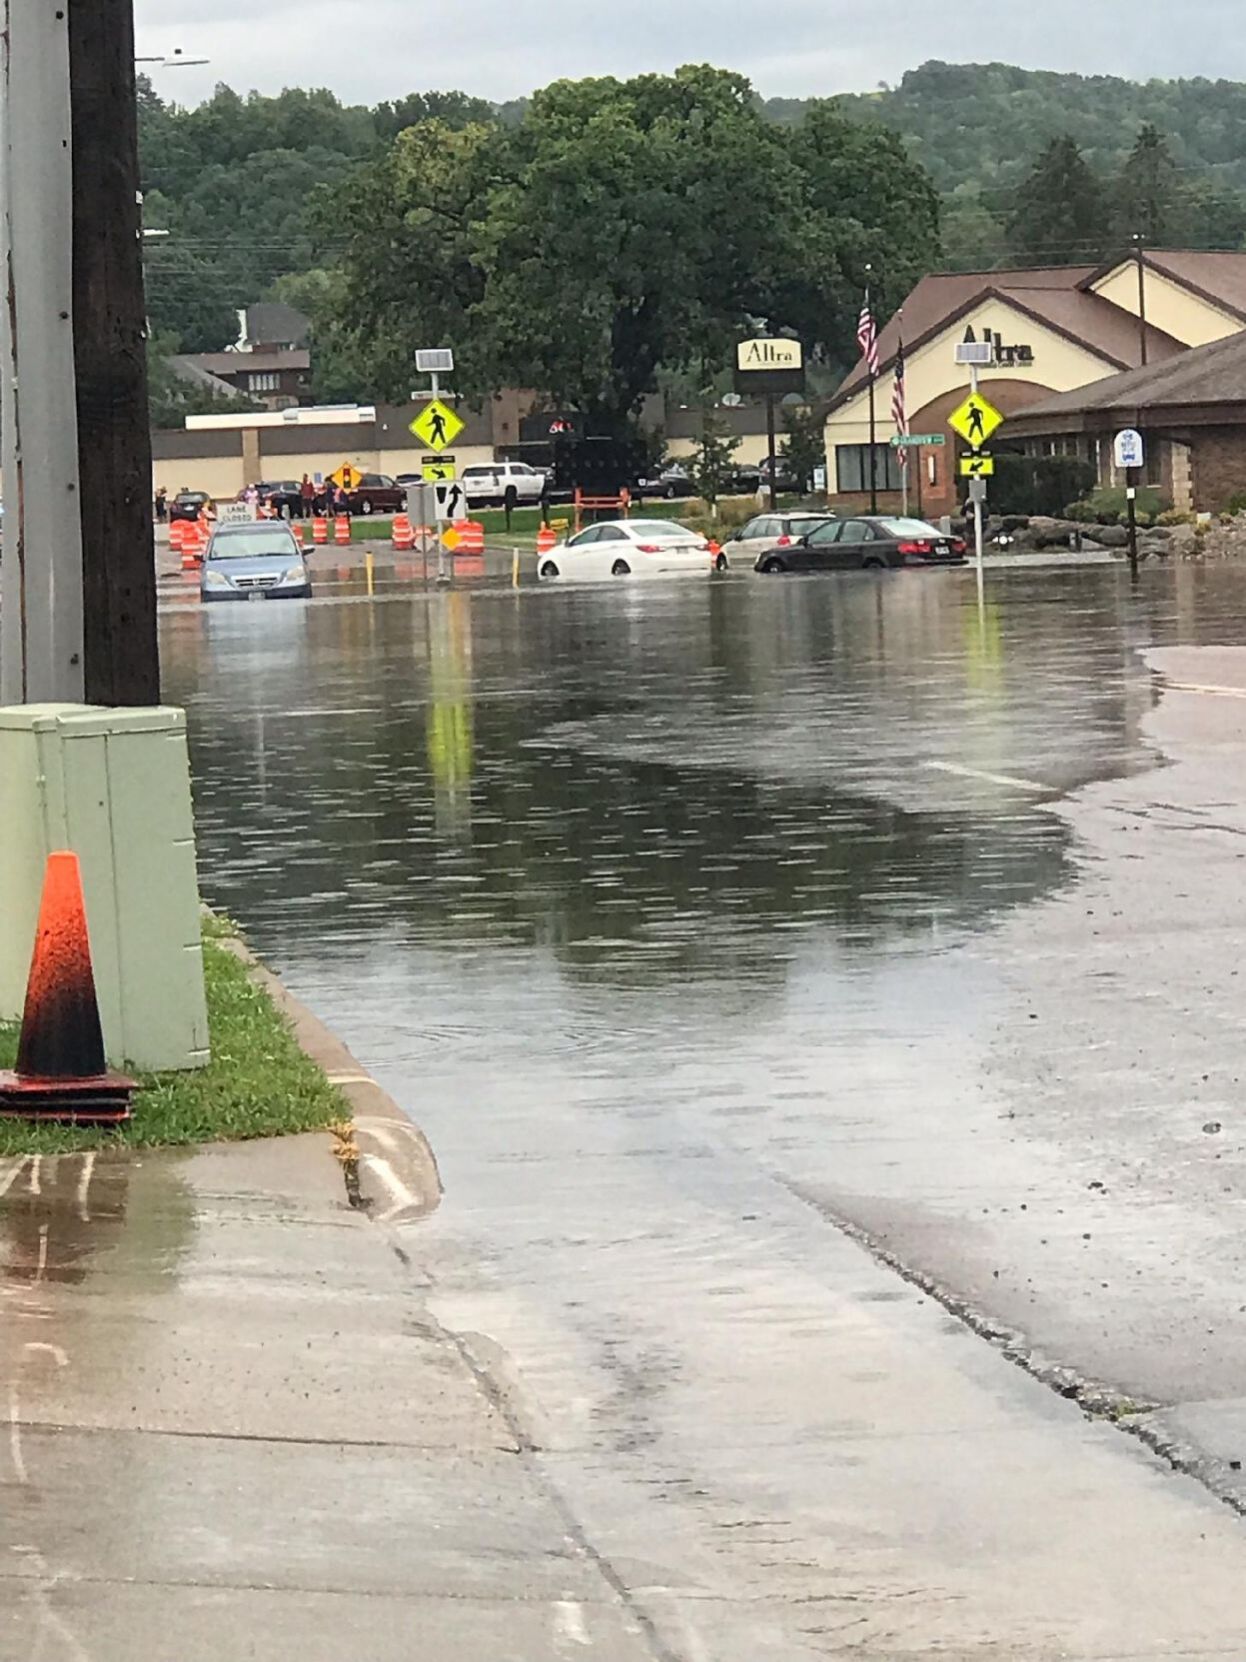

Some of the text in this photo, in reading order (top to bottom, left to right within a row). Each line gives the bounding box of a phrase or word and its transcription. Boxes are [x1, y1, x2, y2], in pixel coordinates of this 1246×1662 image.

[747, 342, 792, 362] Altra
[227, 505, 246, 513] LANE
[222, 514, 252, 522] CLOSED
